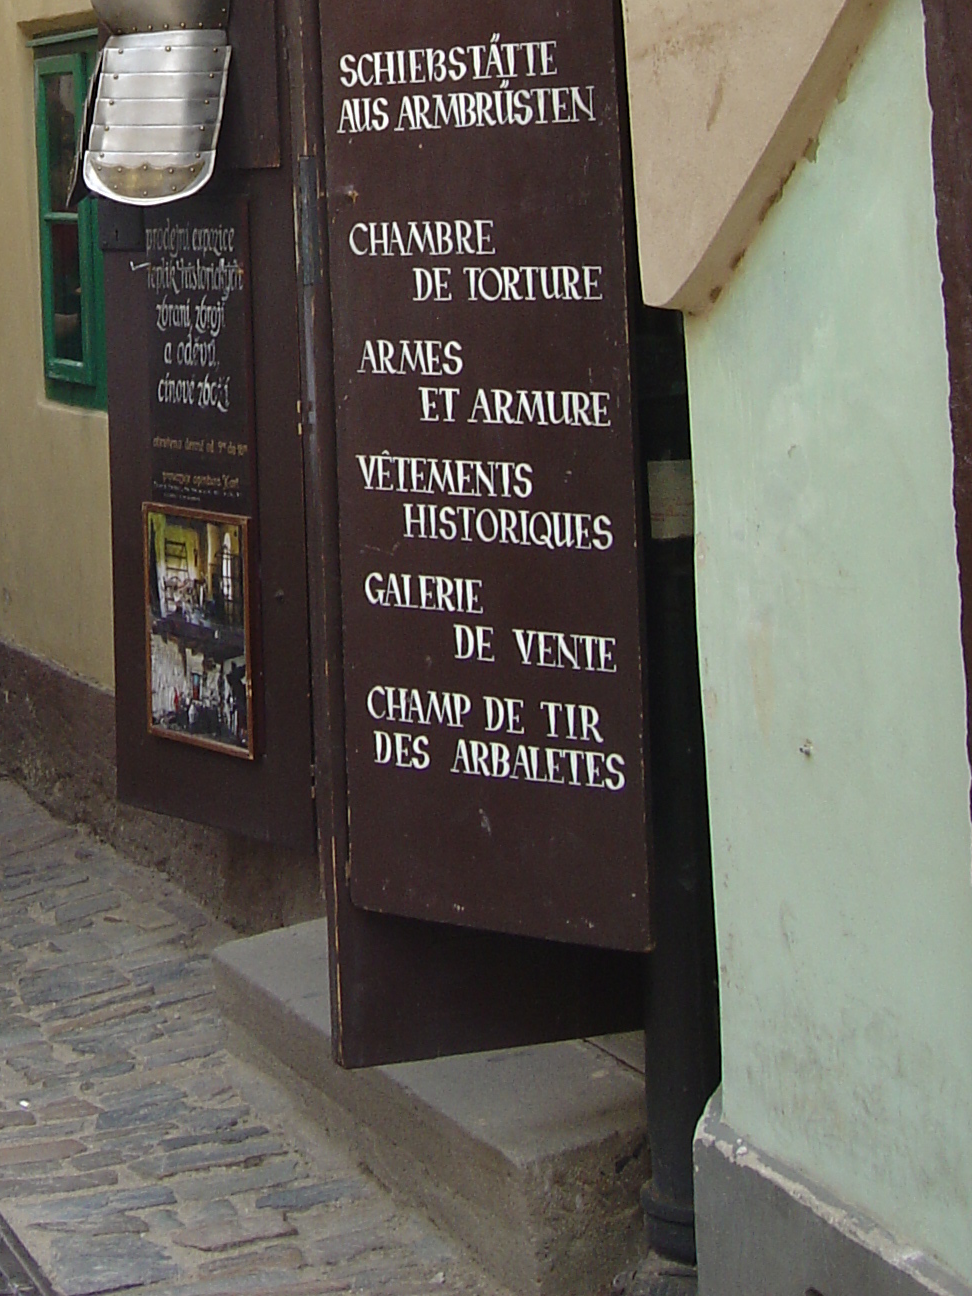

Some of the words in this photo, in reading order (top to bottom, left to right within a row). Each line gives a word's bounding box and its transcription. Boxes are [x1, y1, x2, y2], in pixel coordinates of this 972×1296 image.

[336, 97, 389, 134] AUS
[394, 79, 596, 132] ARMBRÜSTEN
[348, 219, 496, 257] CHAMBRE
[412, 267, 452, 301] DE
[463, 266, 603, 301] TORTURE
[163, 341, 172, 365] a
[357, 339, 464, 376] ARMES
[418, 386, 460, 422] ET
[467, 388, 611, 427] ARMURE
[355, 450, 533, 498] VÊTEMENTS
[402, 503, 614, 550] HISTORIQUES
[364, 572, 484, 614] GALERIE
[453, 623, 495, 662] DE
[512, 628, 618, 673] VENTE
[367, 685, 471, 728] CHAMP
[483, 696, 525, 735] DE
[540, 701, 604, 744] TIR
[373, 730, 430, 770] DES
[450, 739, 626, 791] ARBALETES
